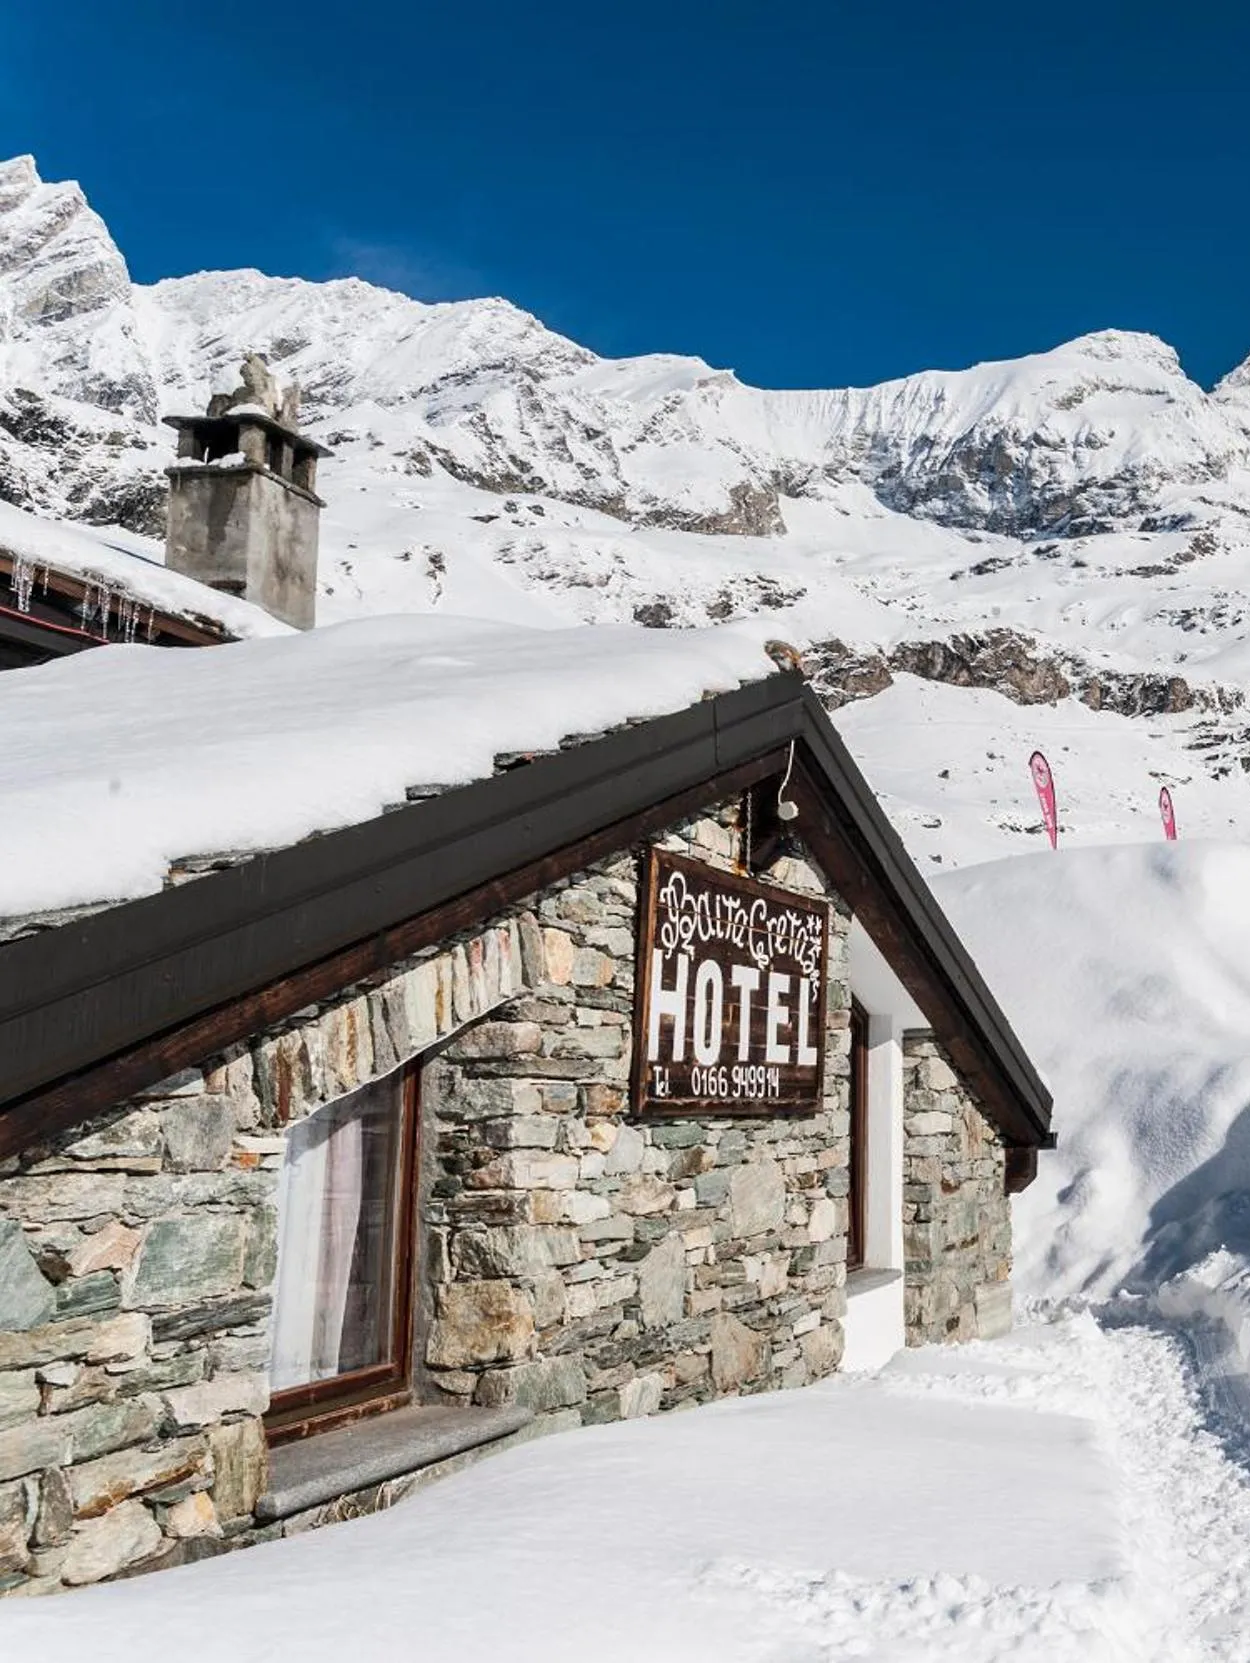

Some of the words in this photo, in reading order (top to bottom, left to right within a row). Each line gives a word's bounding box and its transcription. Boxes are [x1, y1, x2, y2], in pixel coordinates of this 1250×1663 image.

[660, 871, 748, 960] Baita
[648, 948, 818, 1066] HOTEL
[691, 1066, 728, 1097] 0166
[731, 1065, 779, 1098] 949914
